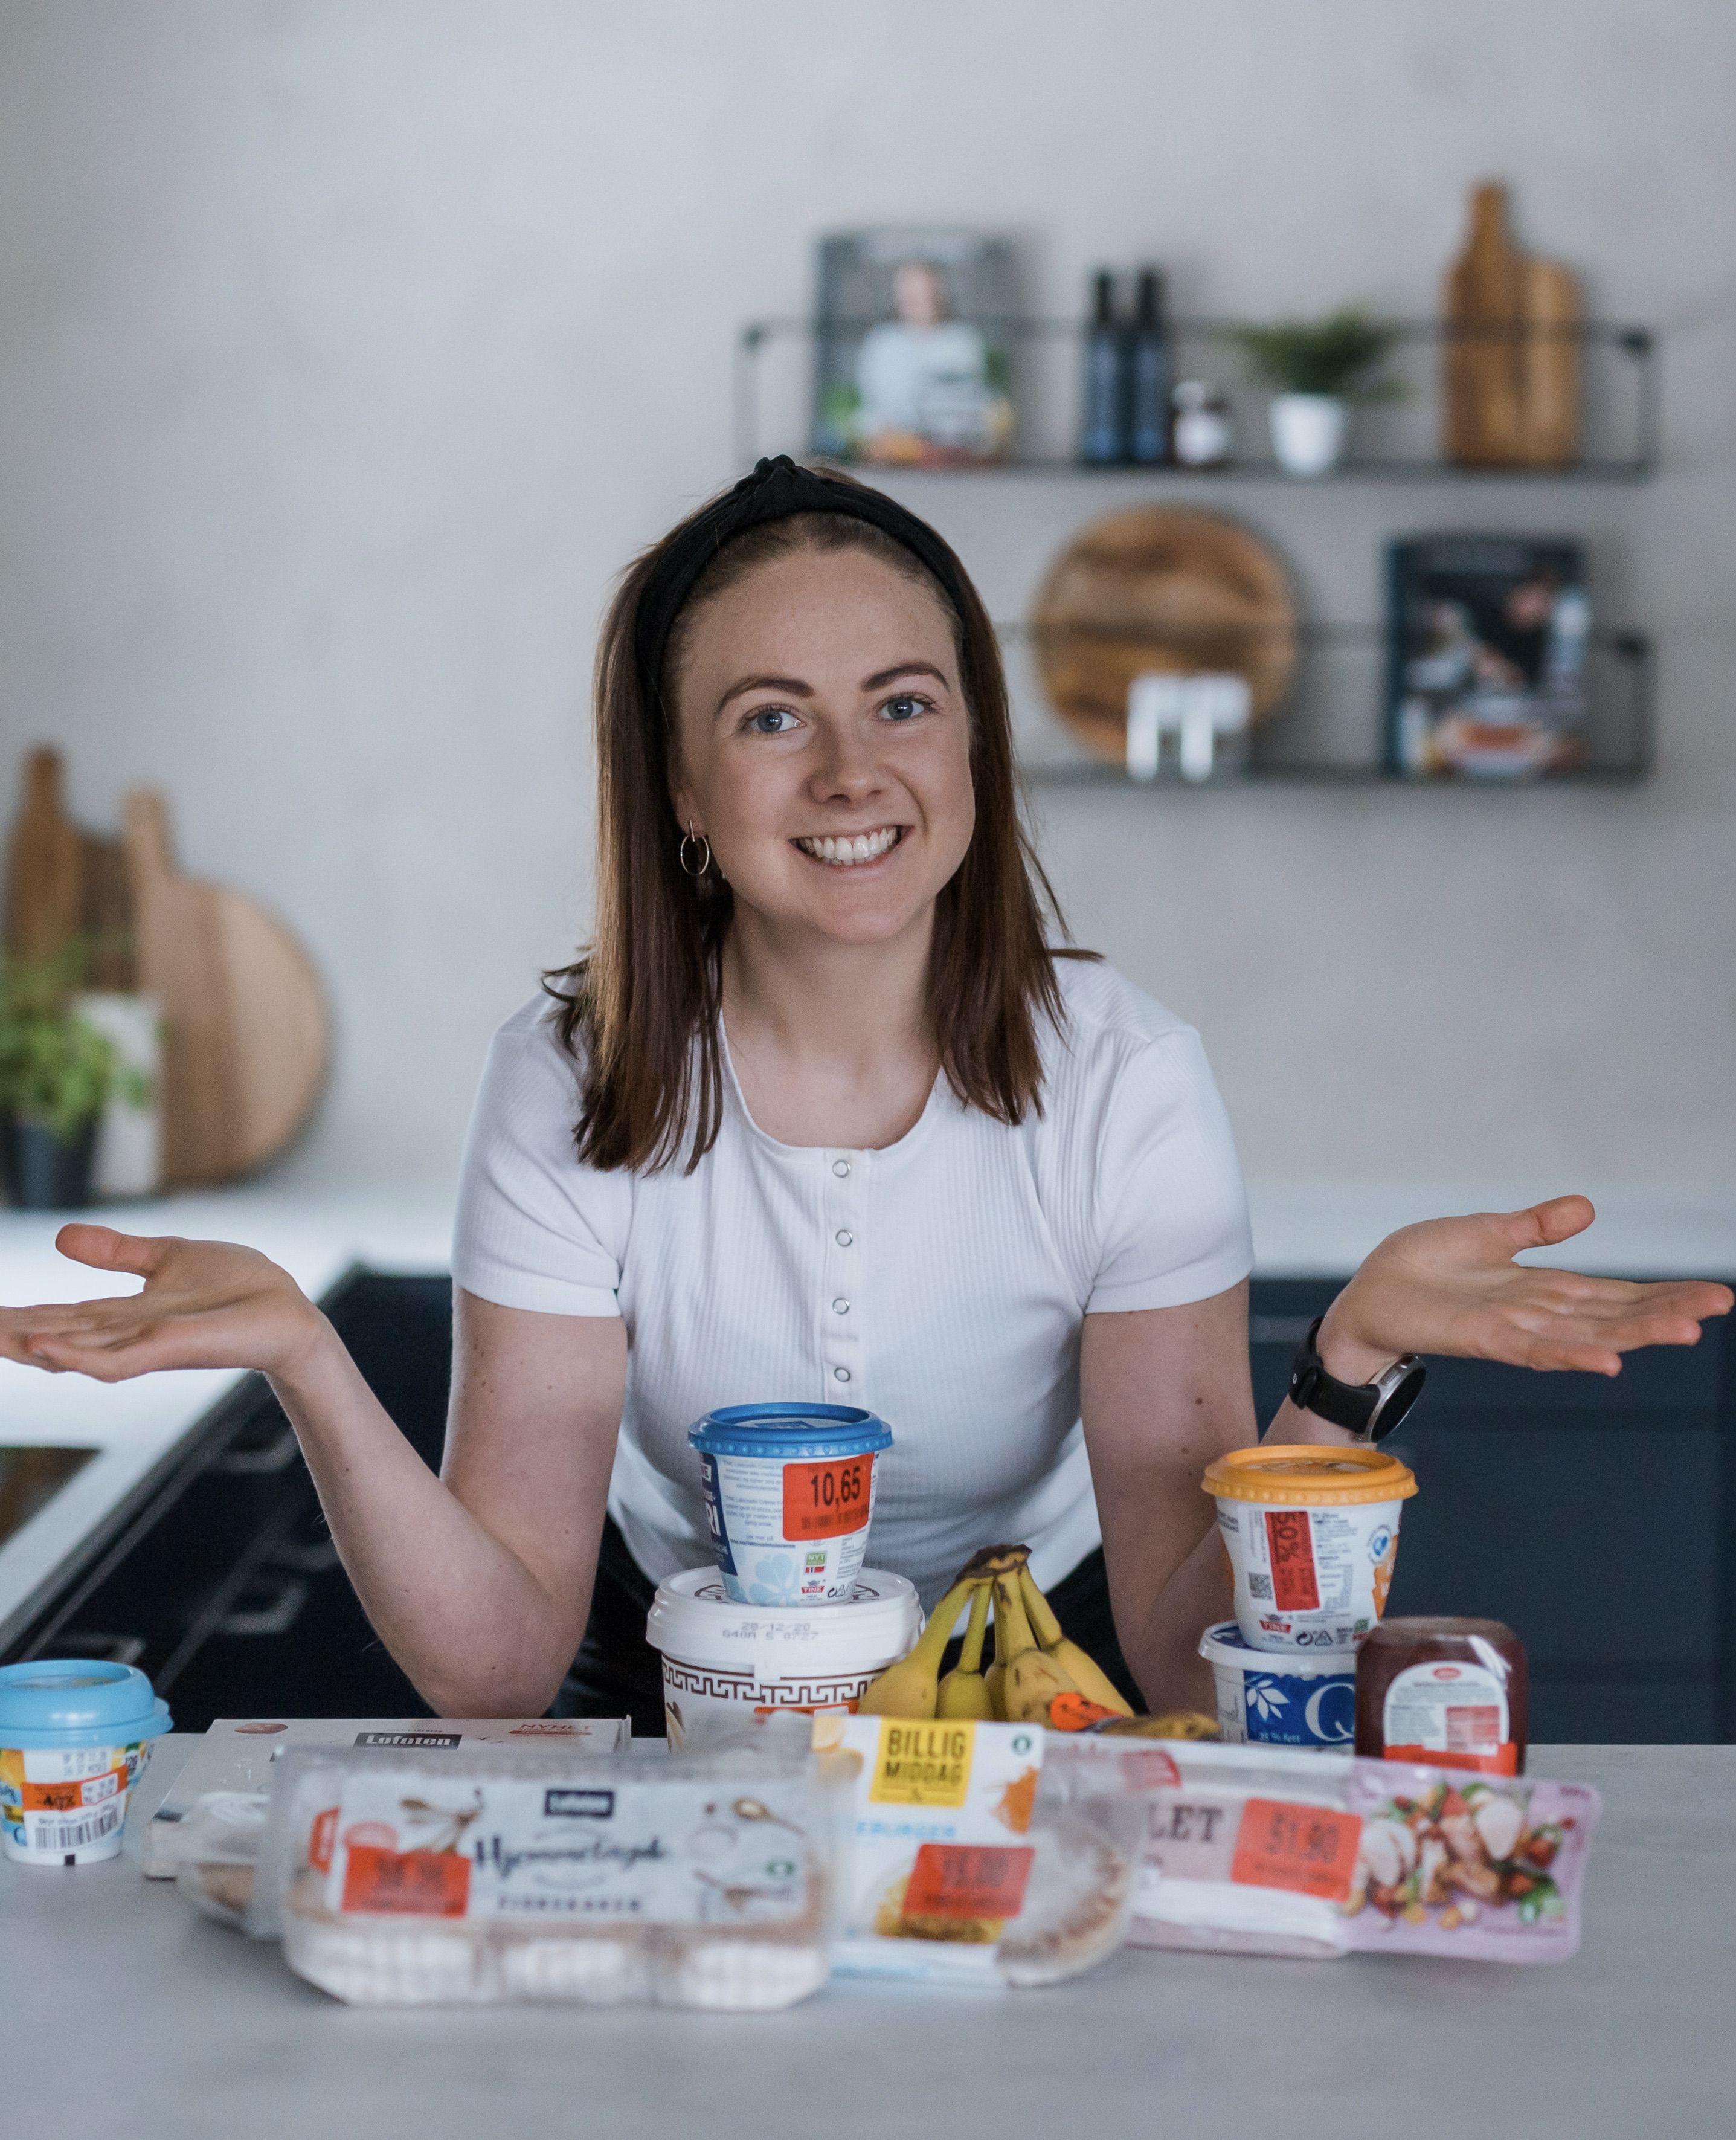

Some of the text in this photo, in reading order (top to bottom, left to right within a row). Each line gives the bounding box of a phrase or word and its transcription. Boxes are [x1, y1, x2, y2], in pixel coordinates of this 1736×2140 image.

[810, 1465, 861, 1512] 10,65
[365, 1735, 452, 1745] Lofoten
[887, 1727, 965, 1759] BILLIG
